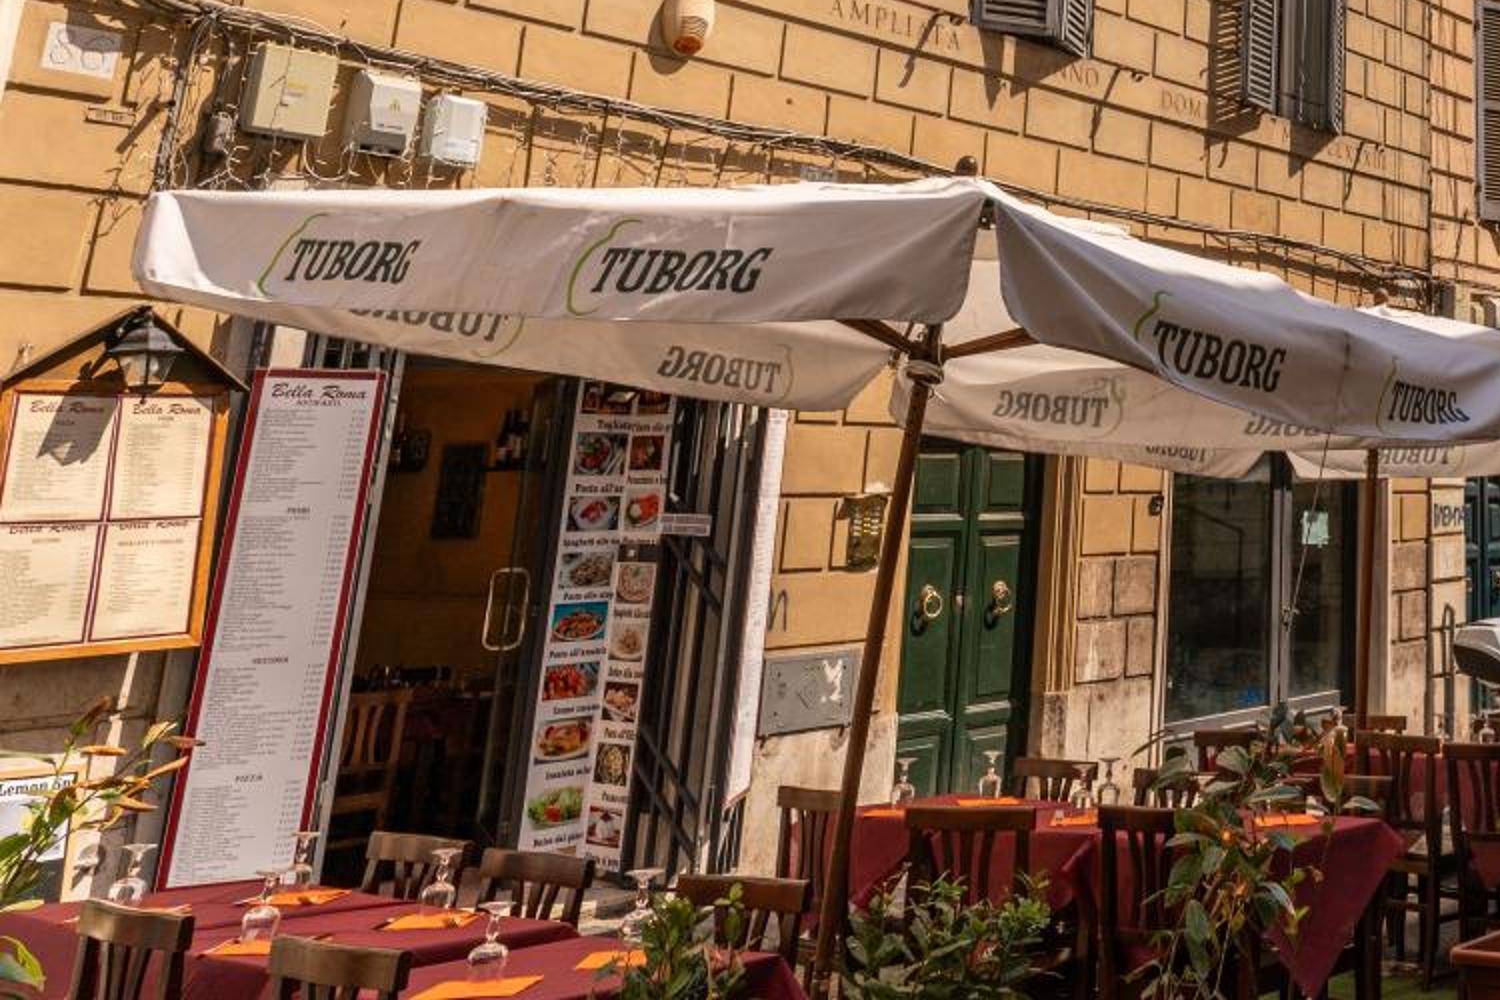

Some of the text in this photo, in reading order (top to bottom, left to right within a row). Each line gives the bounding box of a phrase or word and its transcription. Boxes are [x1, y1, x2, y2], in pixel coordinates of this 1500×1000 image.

[286, 239, 420, 283] TUBORG
[592, 247, 773, 293] TUBORG
[1153, 320, 1286, 392] TUBORG
[133, 403, 201, 415] Bella Roma
[272, 382, 367, 400] Bella Roma
[1386, 380, 1470, 424] TUBORG
[0, 782, 48, 796] Lemon
